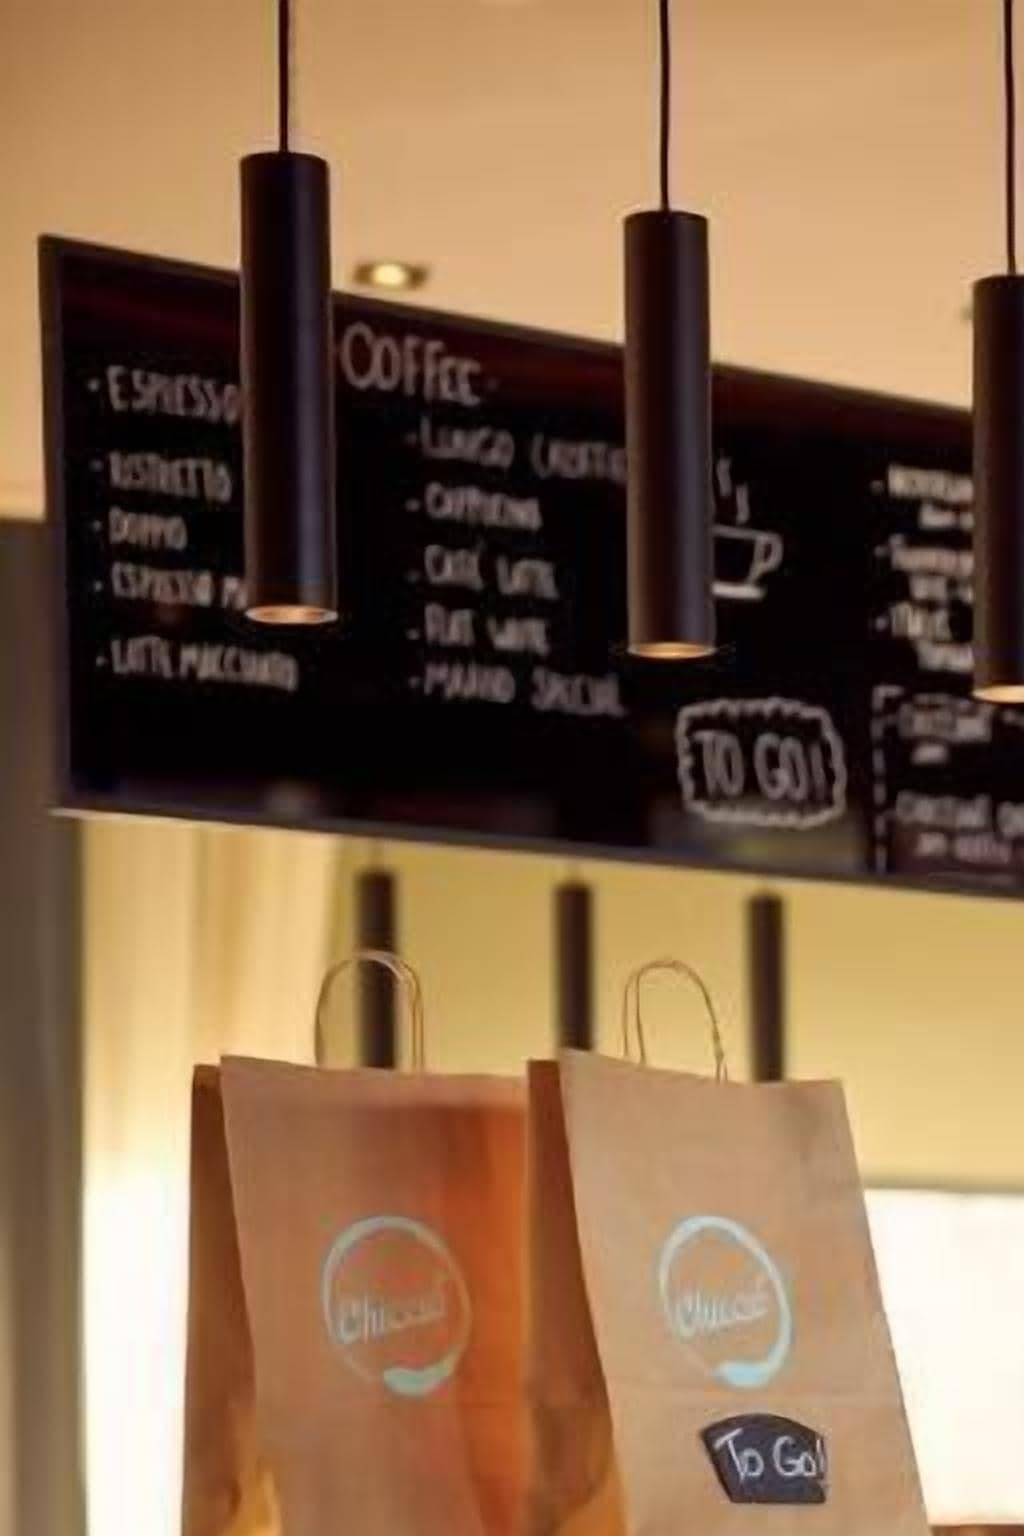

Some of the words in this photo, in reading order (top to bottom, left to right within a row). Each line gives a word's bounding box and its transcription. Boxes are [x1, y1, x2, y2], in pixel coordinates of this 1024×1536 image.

[106, 364, 242, 423] ESPRESSO
[340, 321, 482, 406] COFFEE
[688, 728, 746, 798] TO
[713, 1426, 765, 1482] To
